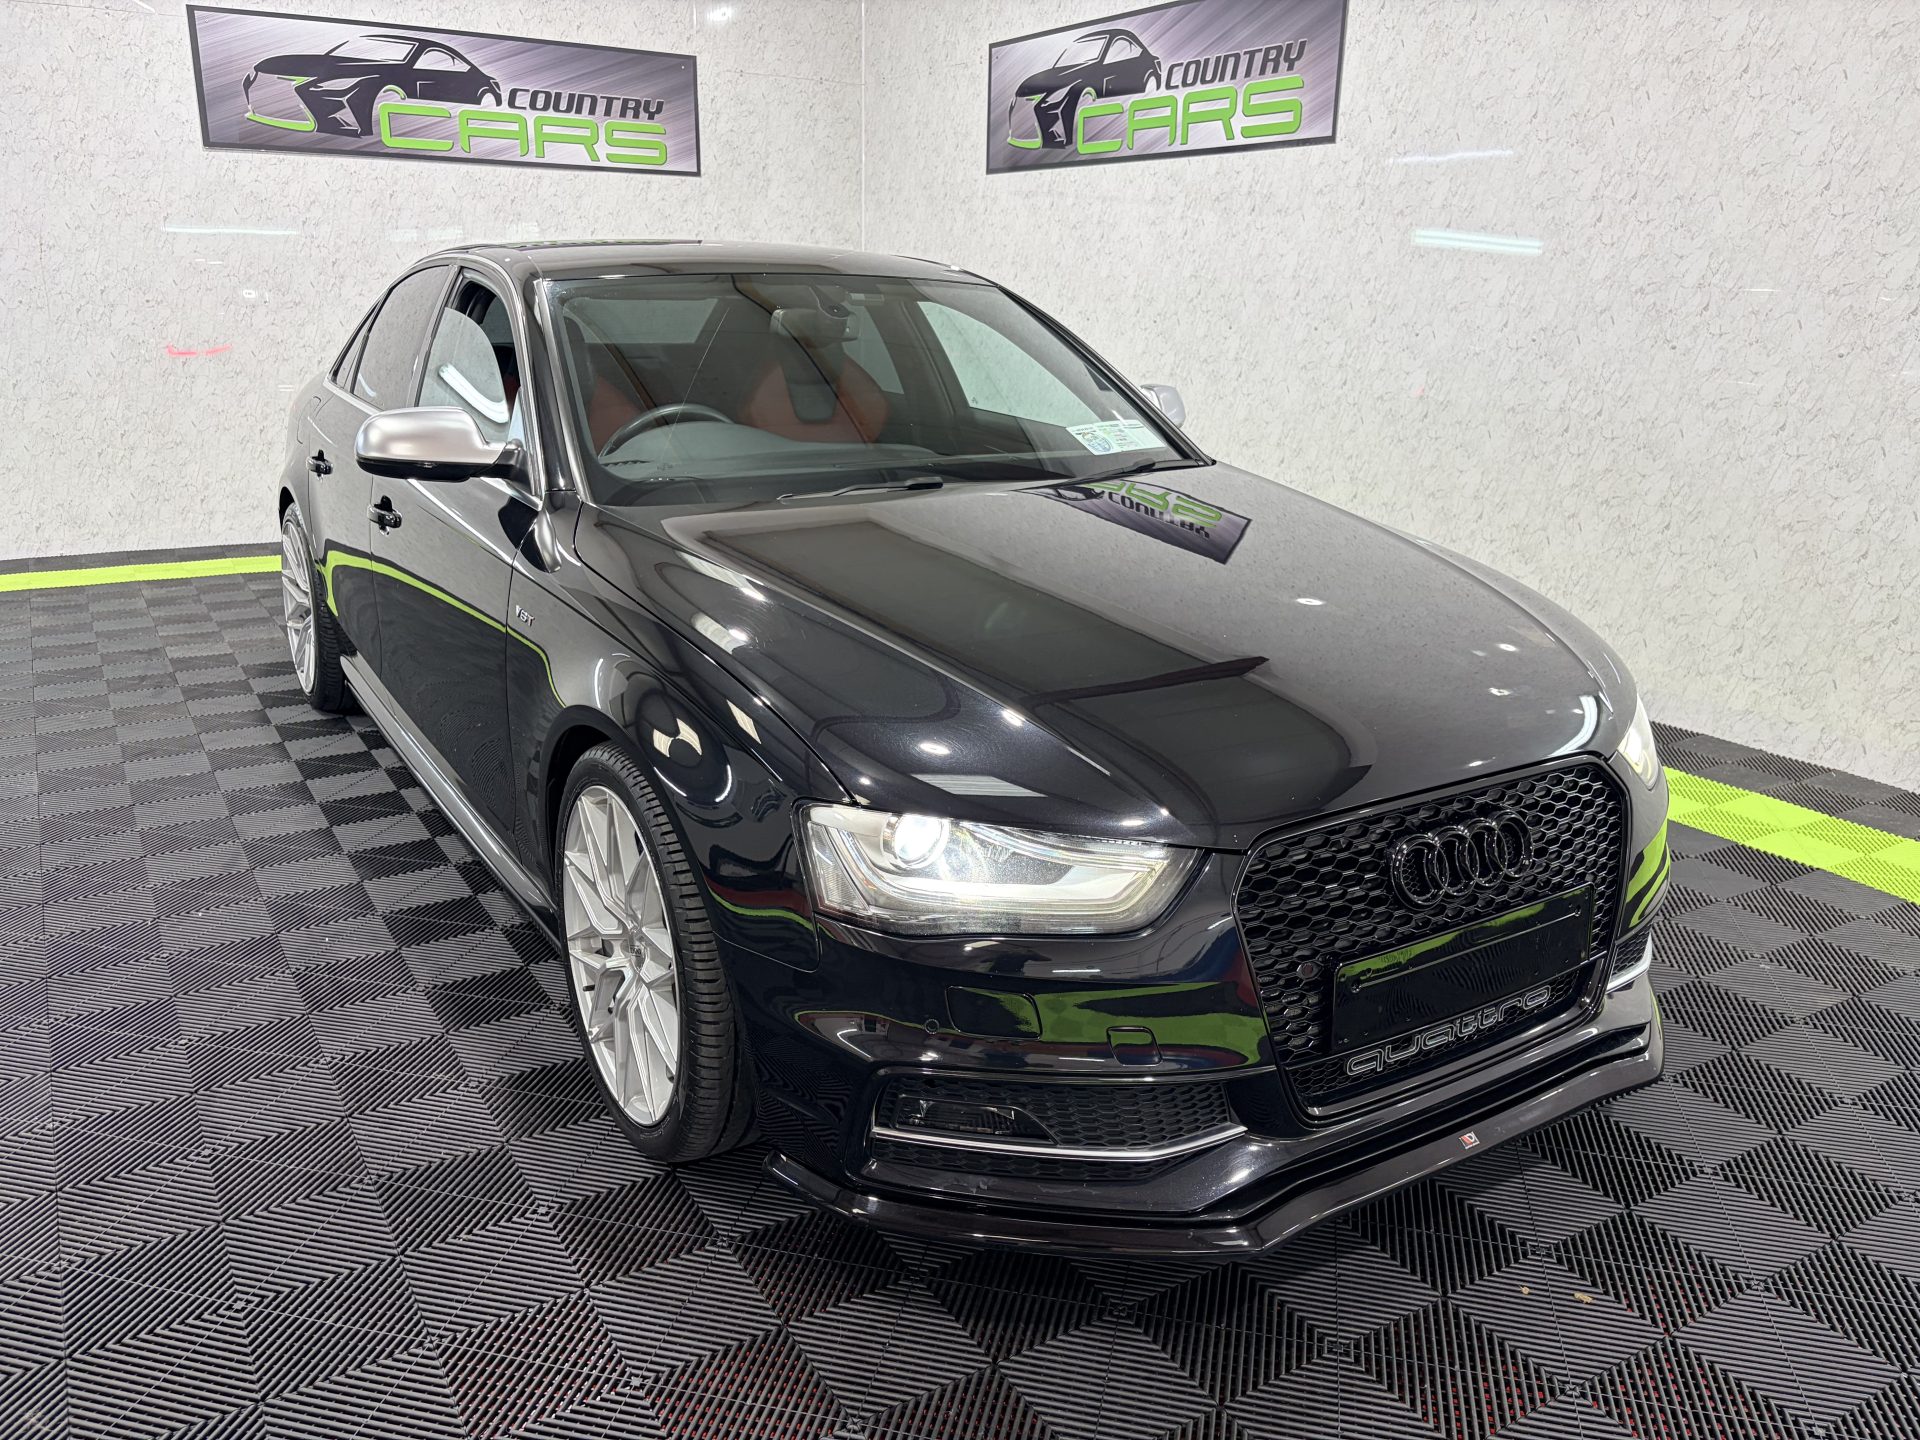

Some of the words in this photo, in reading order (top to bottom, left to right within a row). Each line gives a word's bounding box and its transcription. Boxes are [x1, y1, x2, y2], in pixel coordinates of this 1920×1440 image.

[1165, 40, 1307, 90] COUNTRY
[508, 87, 664, 120] COUNTRY
[1078, 76, 1304, 154] CARS
[379, 104, 668, 165] CARS
[515, 604, 535, 627] V6T
[1347, 984, 1550, 1076] quattro
